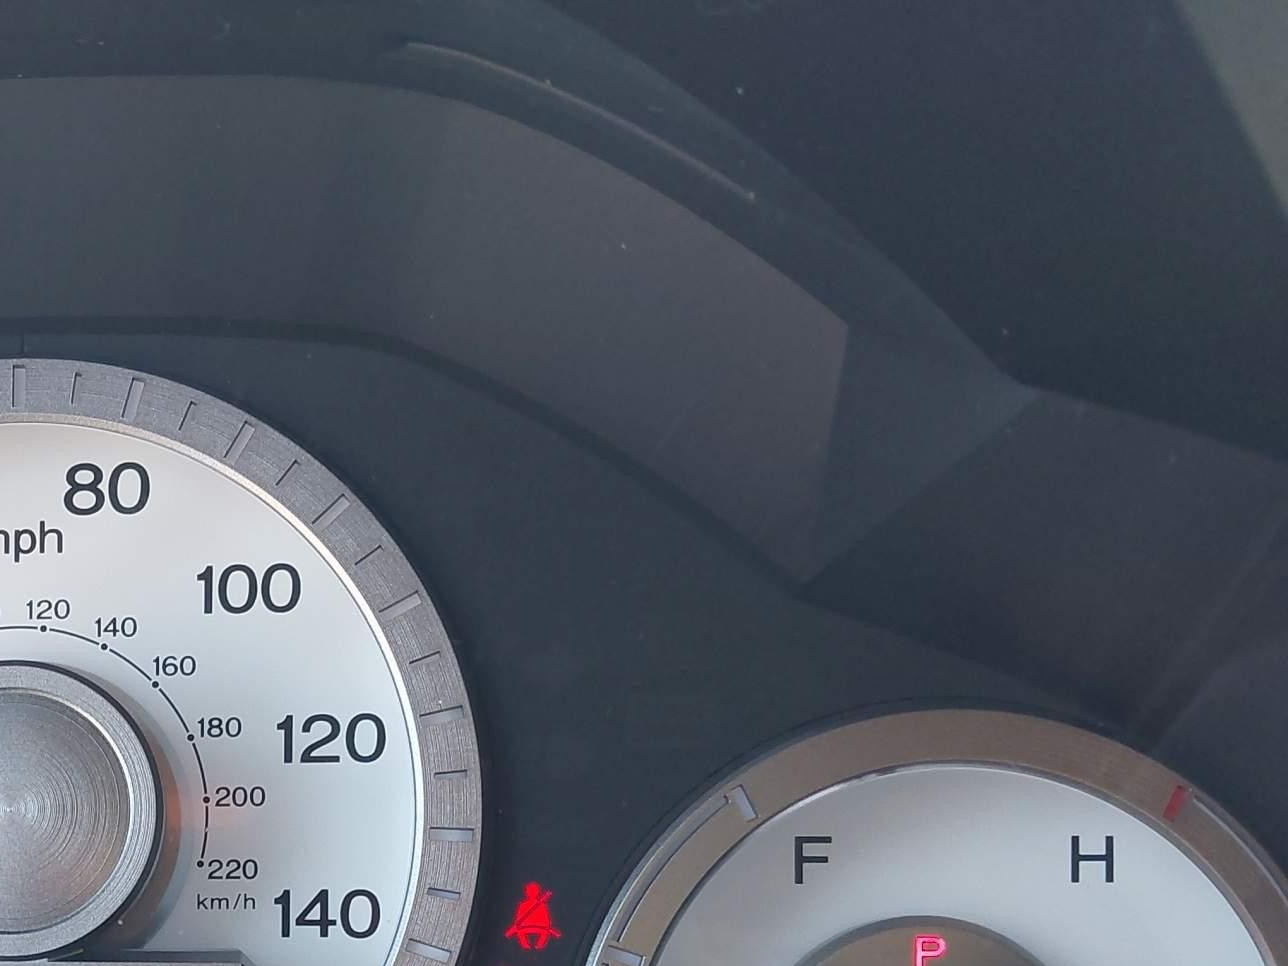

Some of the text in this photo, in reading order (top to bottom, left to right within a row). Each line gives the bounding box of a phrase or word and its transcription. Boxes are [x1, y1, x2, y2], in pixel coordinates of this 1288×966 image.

[63, 462, 150, 515] 80
[196, 563, 301, 614] 100
[26, 599, 71, 620] 120
[94, 618, 138, 638] 140
[153, 656, 197, 676] 160
[197, 717, 242, 738] 180
[277, 713, 387, 764] 120
[214, 787, 266, 807] 200
[207, 859, 259, 880] 220
[794, 836, 832, 884] F
[1071, 836, 1115, 883] H
[196, 892, 257, 911] km/h
[273, 889, 381, 938] 140
